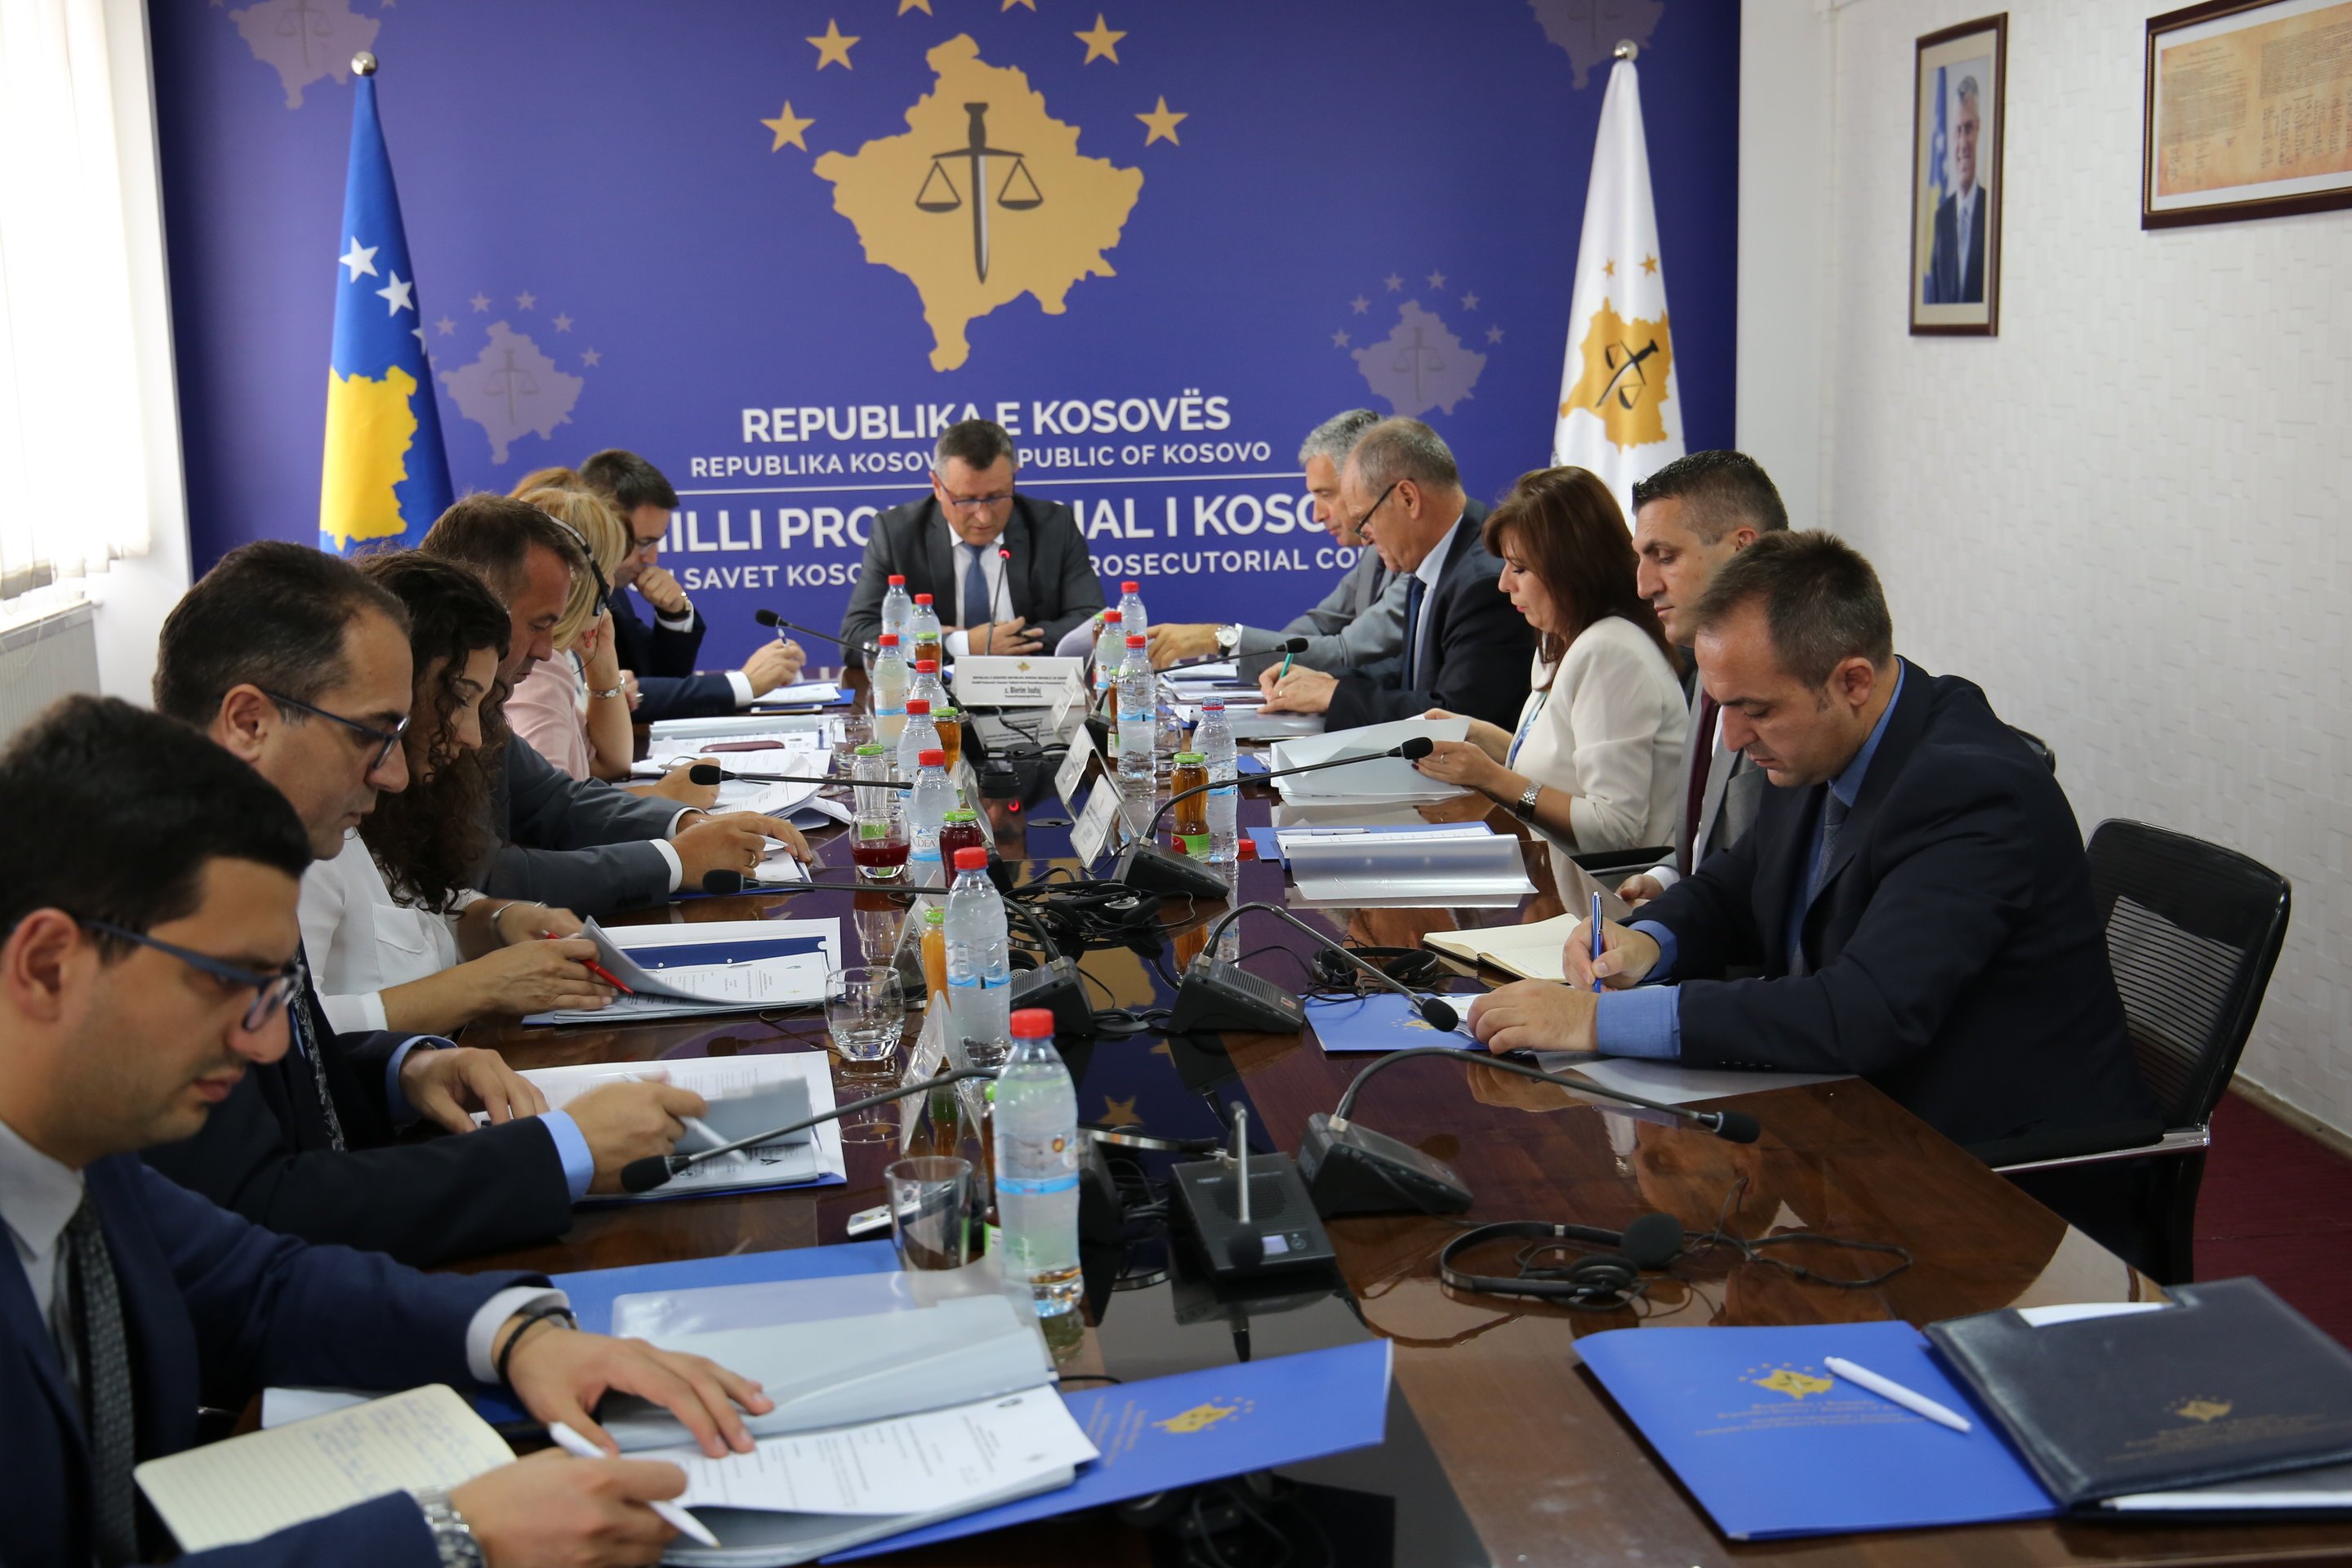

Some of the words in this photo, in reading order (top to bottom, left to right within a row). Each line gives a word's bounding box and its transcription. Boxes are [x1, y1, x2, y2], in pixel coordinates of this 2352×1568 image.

[996, 402, 1022, 436] E
[1033, 388, 1231, 435] KOSOVËS
[691, 453, 844, 478] REPUBLIKA
[850, 451, 935, 473] KOSOV
[1016, 446, 1114, 470] PUBLIC
[1121, 444, 1156, 466] OF
[1163, 441, 1271, 465] KOSOVO
[657, 509, 763, 553] ILLI
[1166, 497, 1178, 537] I
[1194, 493, 1325, 537] KOSO
[684, 564, 779, 590] SAVET
[787, 562, 862, 586] KOSO
[1089, 549, 1309, 577] ROSECUTORIAL
